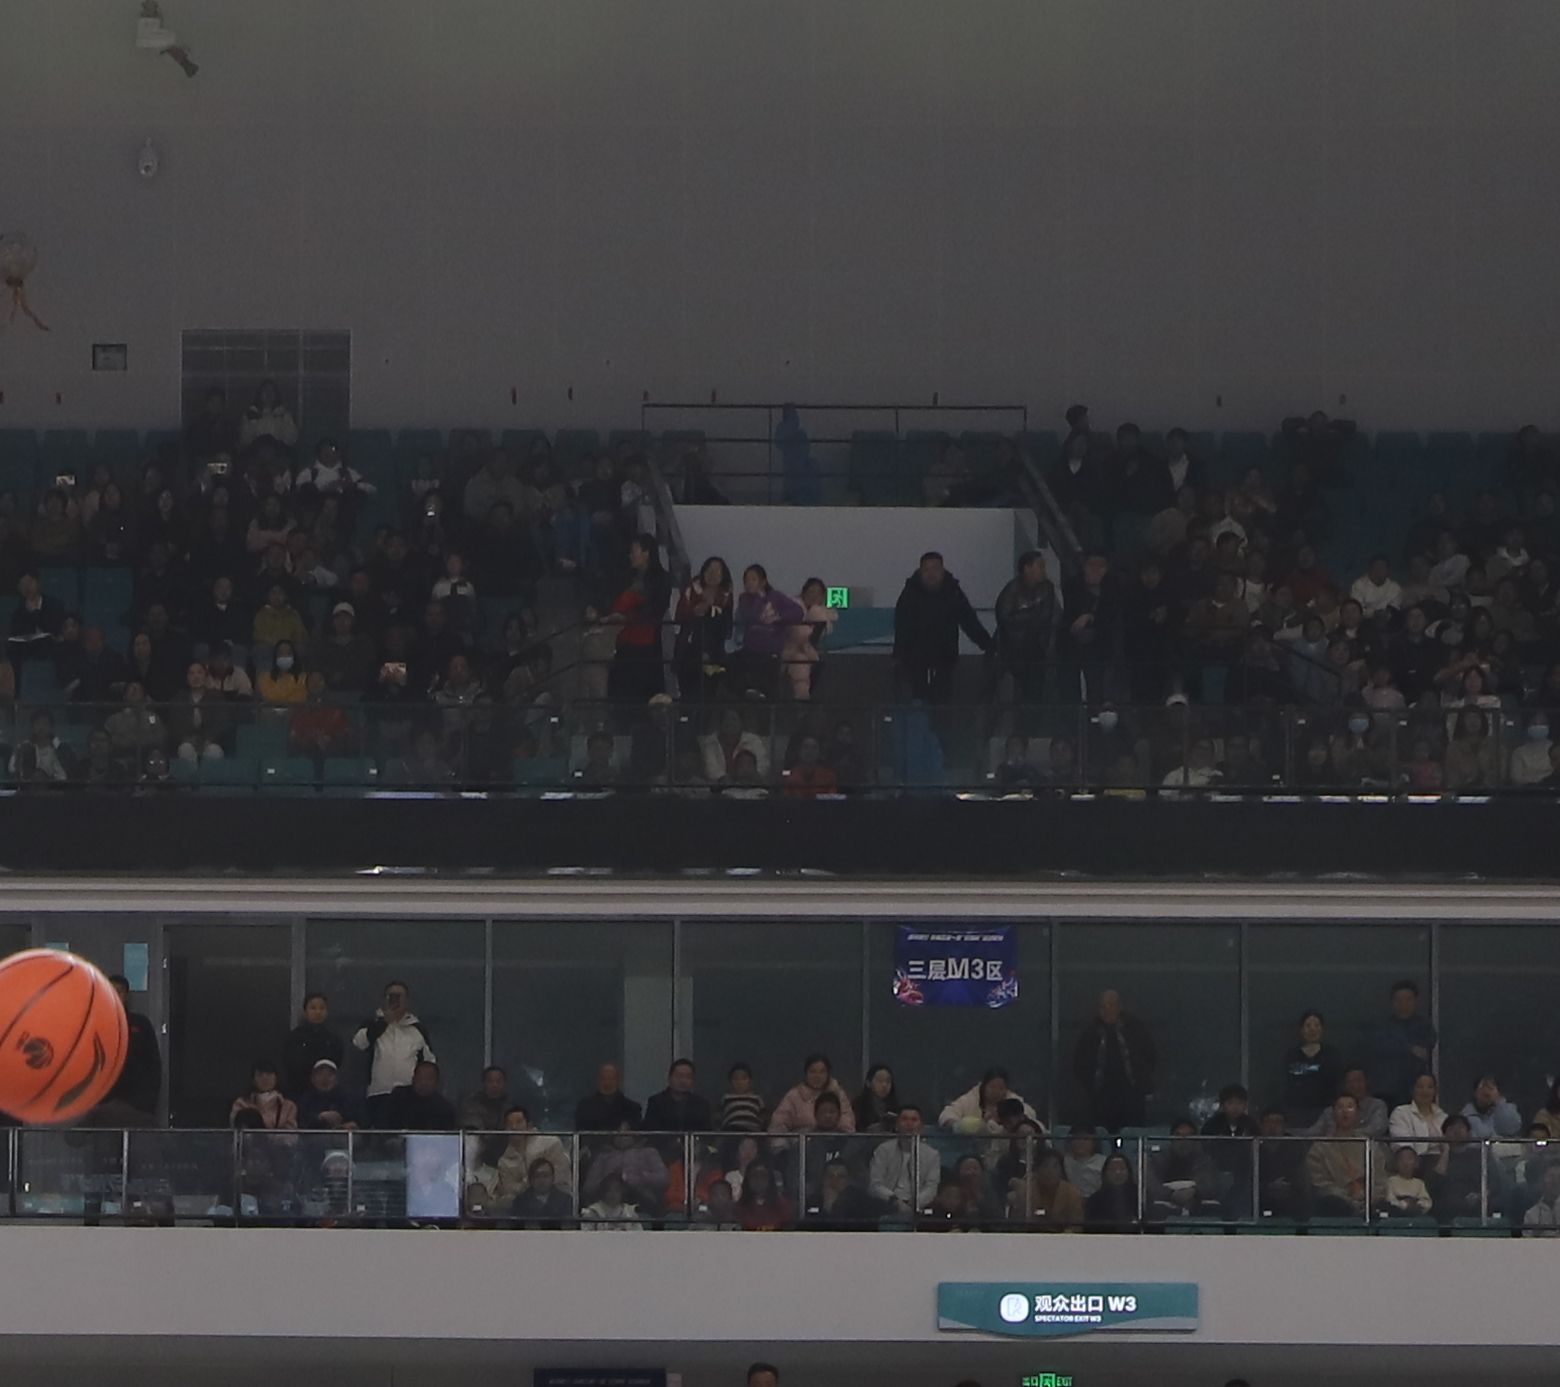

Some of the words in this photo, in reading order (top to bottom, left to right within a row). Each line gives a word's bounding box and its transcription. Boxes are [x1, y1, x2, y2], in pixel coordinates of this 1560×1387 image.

[908, 958, 1004, 982] 三层M3区
[1034, 1294, 1103, 1313] 观众出口
[1108, 1296, 1137, 1312] W3
